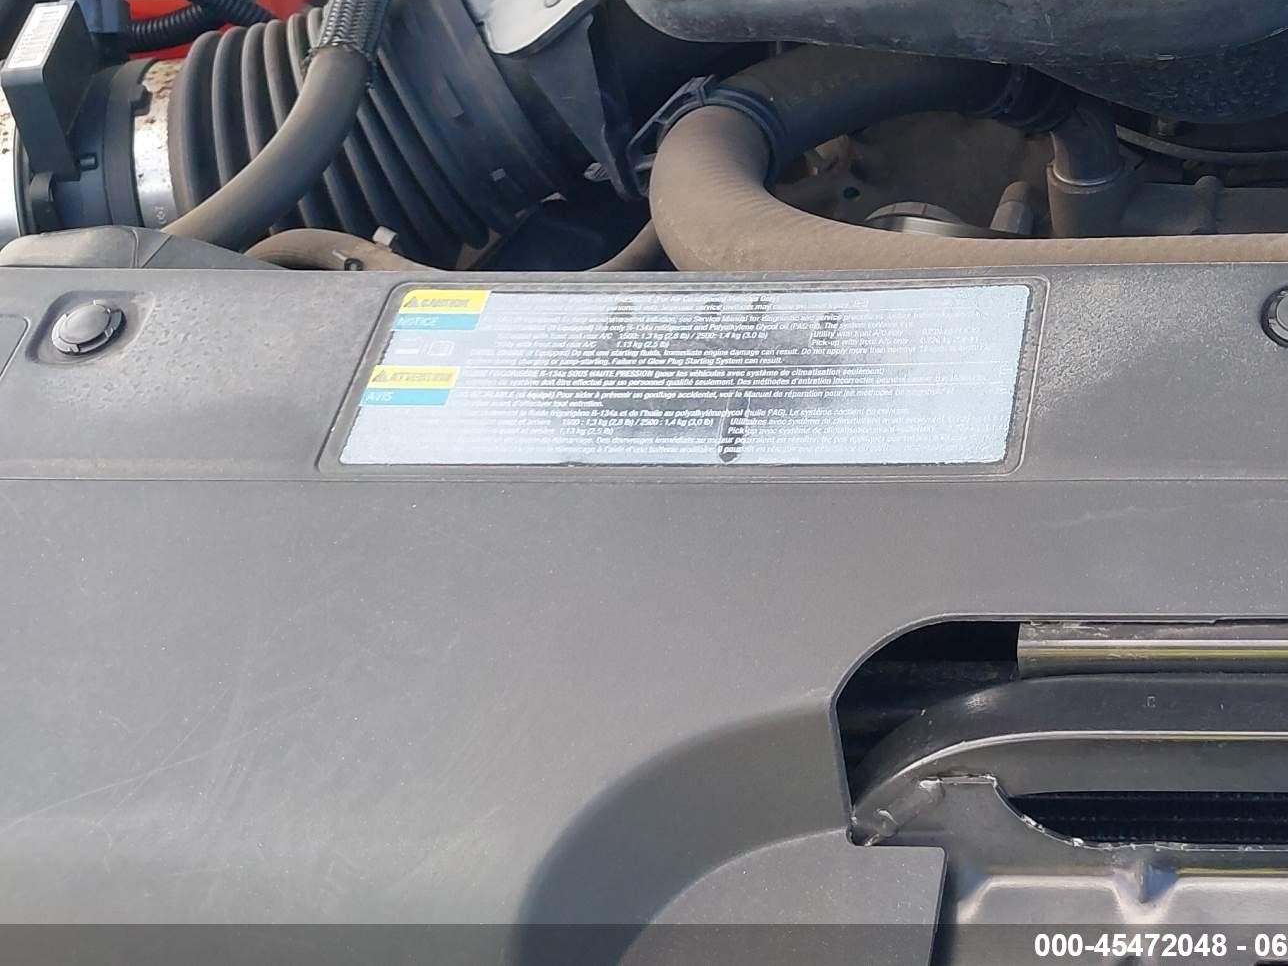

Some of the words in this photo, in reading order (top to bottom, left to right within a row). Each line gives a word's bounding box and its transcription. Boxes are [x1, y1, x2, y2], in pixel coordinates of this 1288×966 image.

[399, 316, 440, 326] NOTICE
[610, 324, 625, 333] only
[755, 323, 777, 331] Glycol
[730, 333, 741, 341] kg
[814, 330, 835, 339] Utility
[633, 341, 643, 349] kg
[811, 339, 840, 347] Pick-up
[610, 349, 639, 358] starting
[703, 349, 729, 357] engine
[729, 349, 759, 357] damage
[826, 347, 847, 356] apply
[667, 358, 684, 366] Plug
[685, 358, 715, 366] Starting
[716, 358, 743, 366] System
[655, 370, 674, 379] (pour
[747, 369, 779, 378] système
[603, 380, 615, 388] par
[628, 379, 665, 387] personnel
[666, 379, 693, 387] qualifié
[365, 392, 394, 402] AVIS
[601, 391, 632, 400] prévenir
[644, 391, 676, 400] gonflage
[678, 391, 718, 400] accidentel,
[744, 390, 771, 398] Manuel
[784, 390, 823, 399] réparation
[677, 419, 688, 427] kg
[703, 419, 714, 427] lb)
